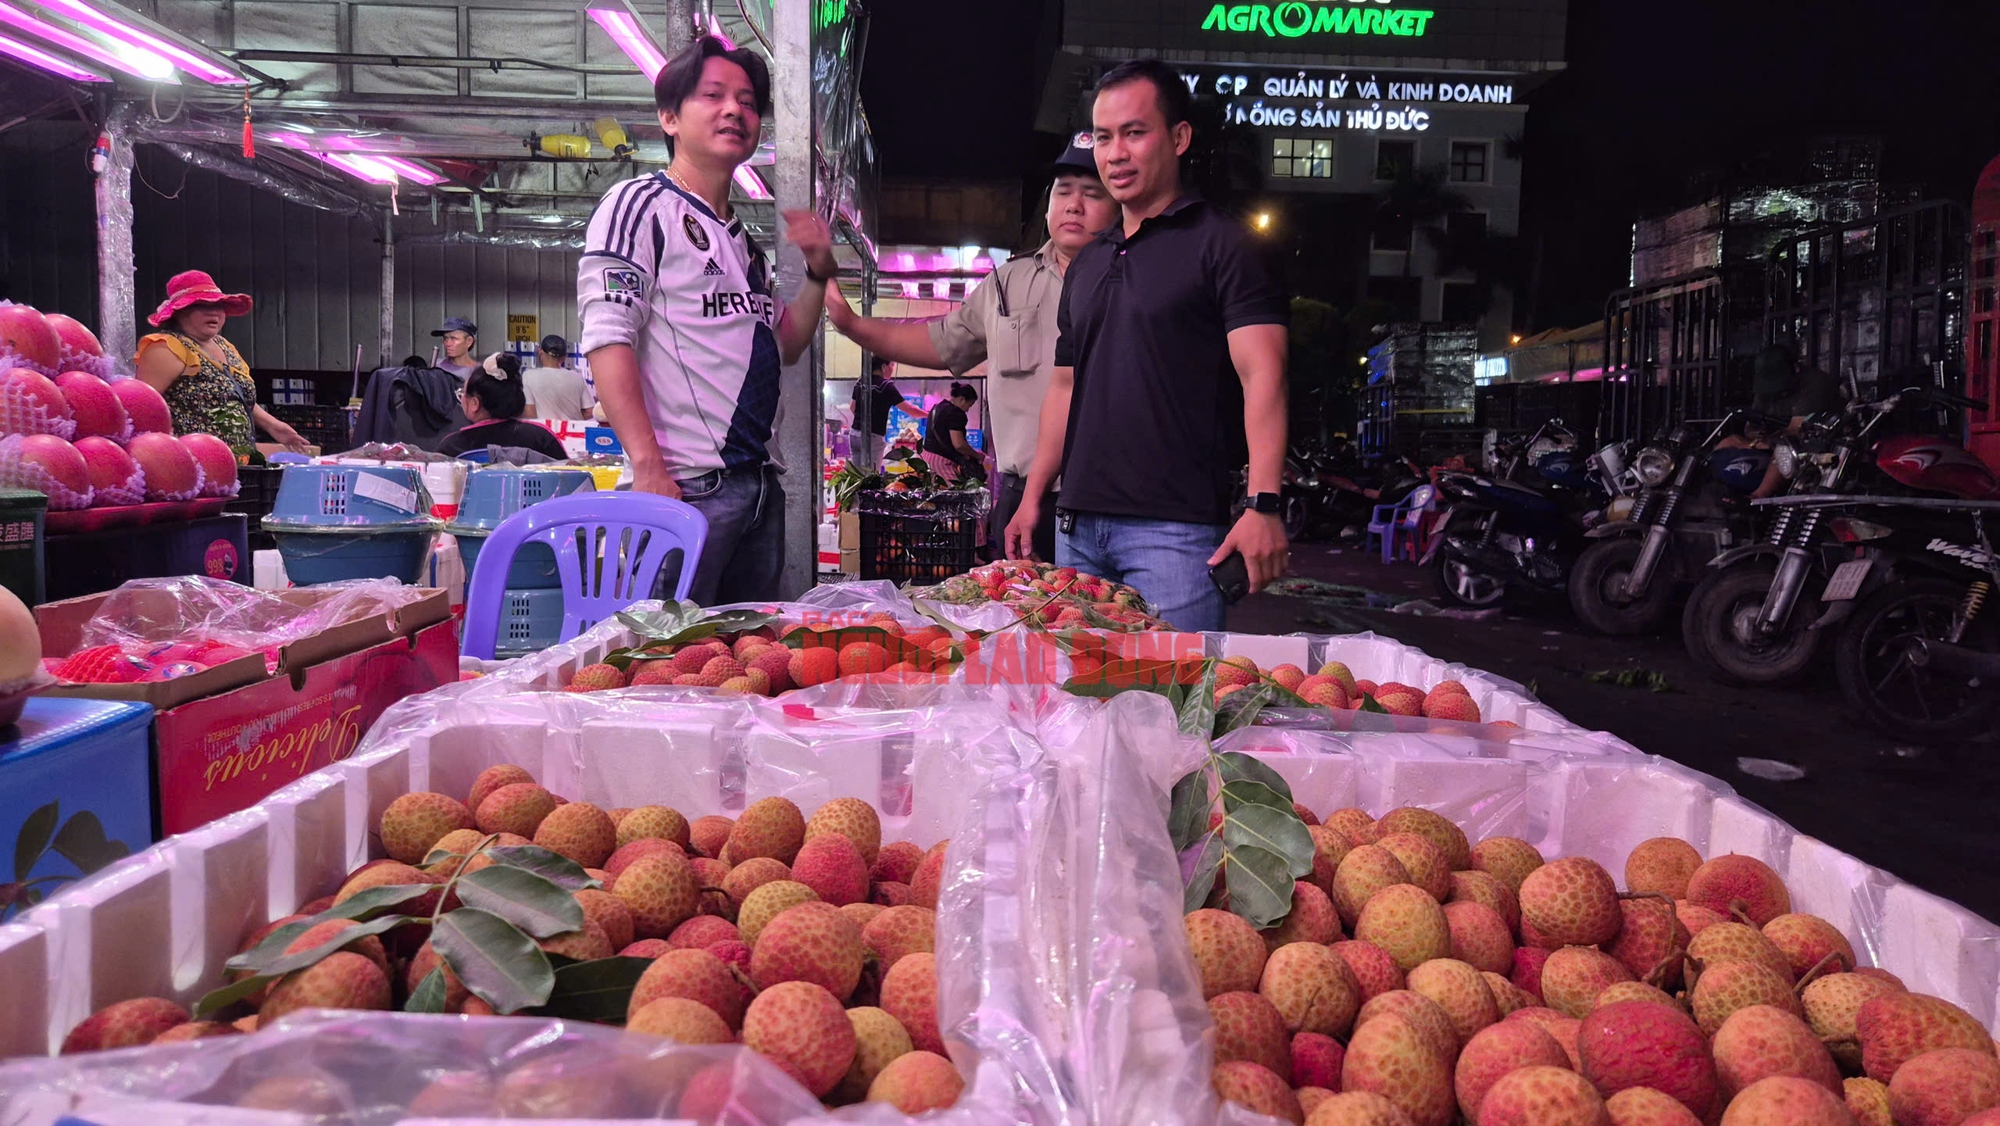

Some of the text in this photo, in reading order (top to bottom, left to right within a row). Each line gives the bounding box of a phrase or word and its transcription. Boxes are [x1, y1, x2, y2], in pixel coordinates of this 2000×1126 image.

[1201, 2, 1434, 37] AGROMARKET
[1263, 71, 1323, 98] QUẢN
[1329, 73, 1349, 98] LÝ
[1356, 75, 1380, 99] VÀ
[1388, 82, 1433, 101] KINH
[1439, 83, 1512, 104] DOANH
[1300, 101, 1340, 128] SẢN
[1346, 102, 1382, 130] THỦ
[1386, 105, 1429, 131] ĐỨC
[509, 315, 536, 324] CAUTION
[207, 558, 224, 574] 998
[203, 704, 362, 791] Delicious
